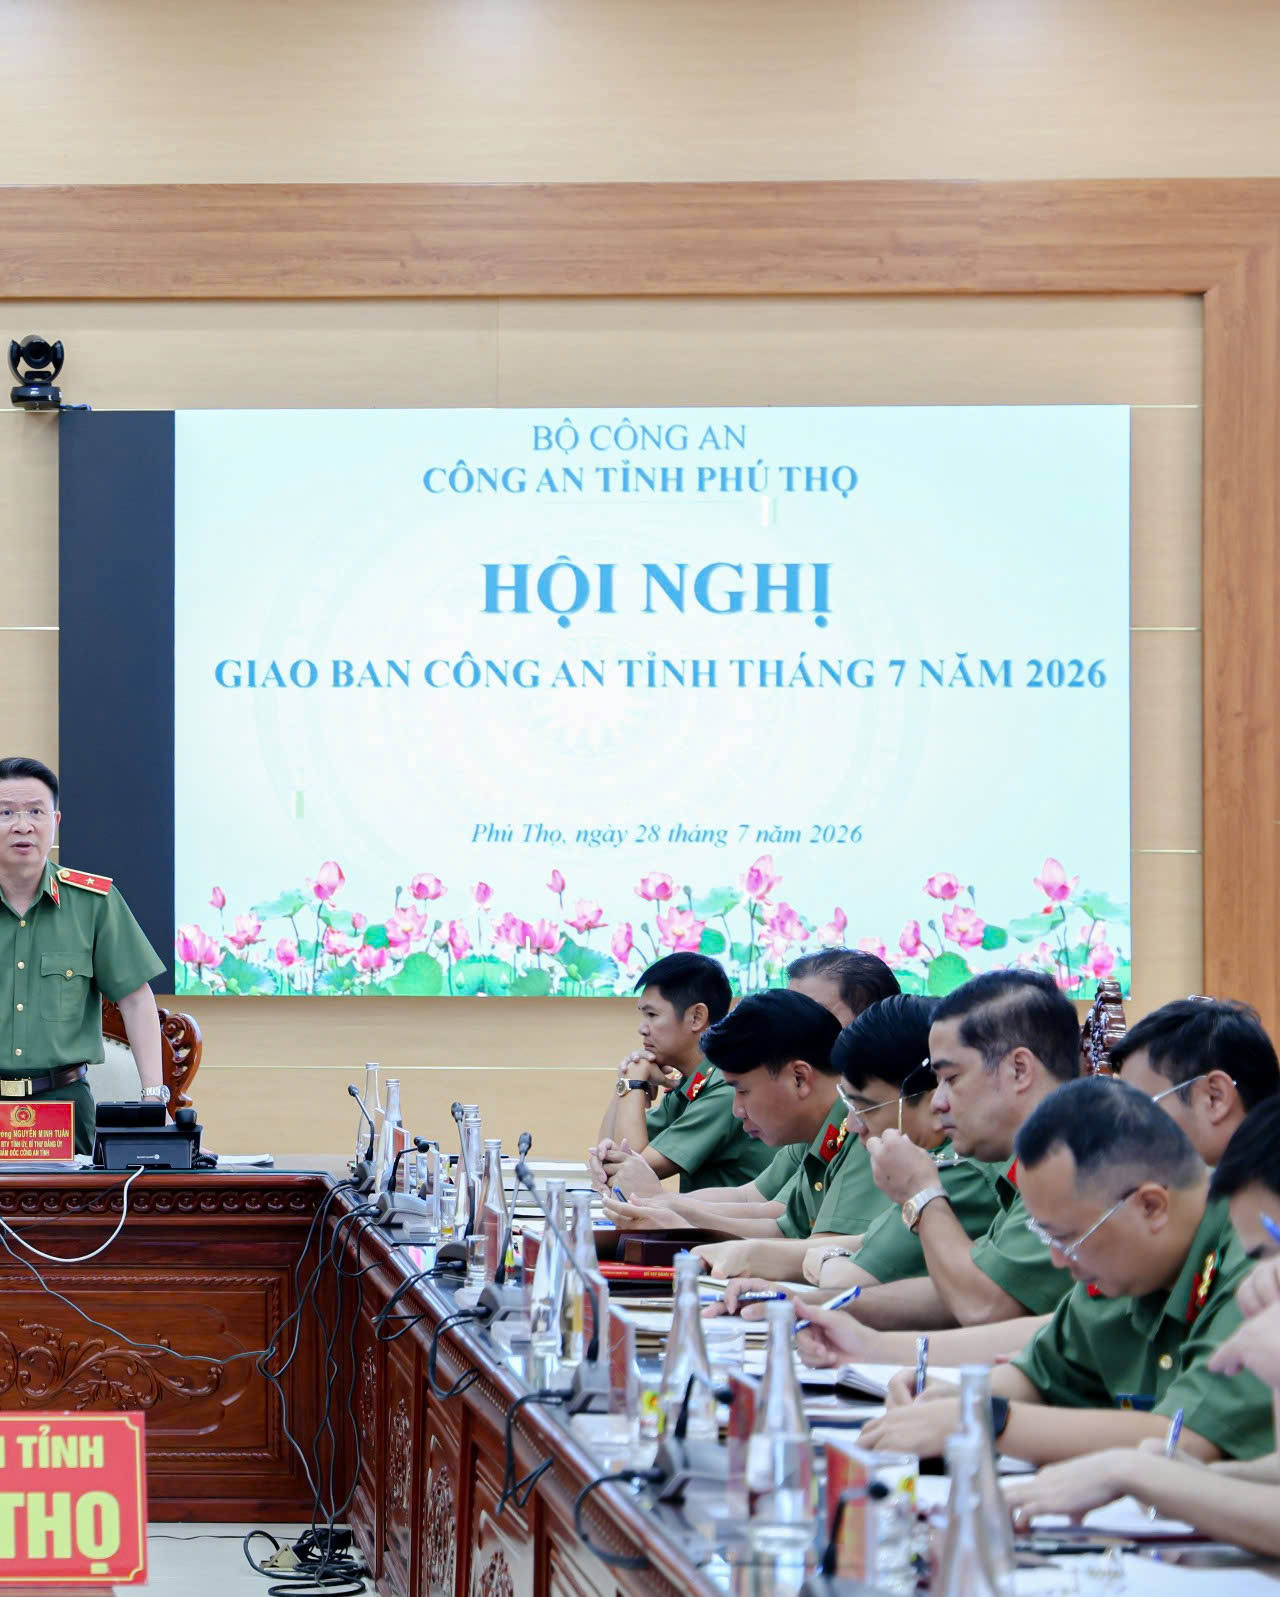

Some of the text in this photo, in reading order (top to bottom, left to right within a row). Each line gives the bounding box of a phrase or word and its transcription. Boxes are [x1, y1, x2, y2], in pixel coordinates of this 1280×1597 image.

[532, 417, 746, 454] BỘ CÔNG AN
[422, 459, 859, 499] CÔNG AN TỈNH PHÚ THỌ
[481, 554, 832, 629] HỘI NGHỊ
[214, 650, 1107, 689] GIAO BAN CÔNG AN TỈNH THÁNG 7 NĂM 2026
[471, 822, 863, 849] Phú Thọ, ngày 28 tháng 7 năm 2026
[38, 1130, 53, 1138] MINH
[16, 1425, 104, 1469] TỈNH
